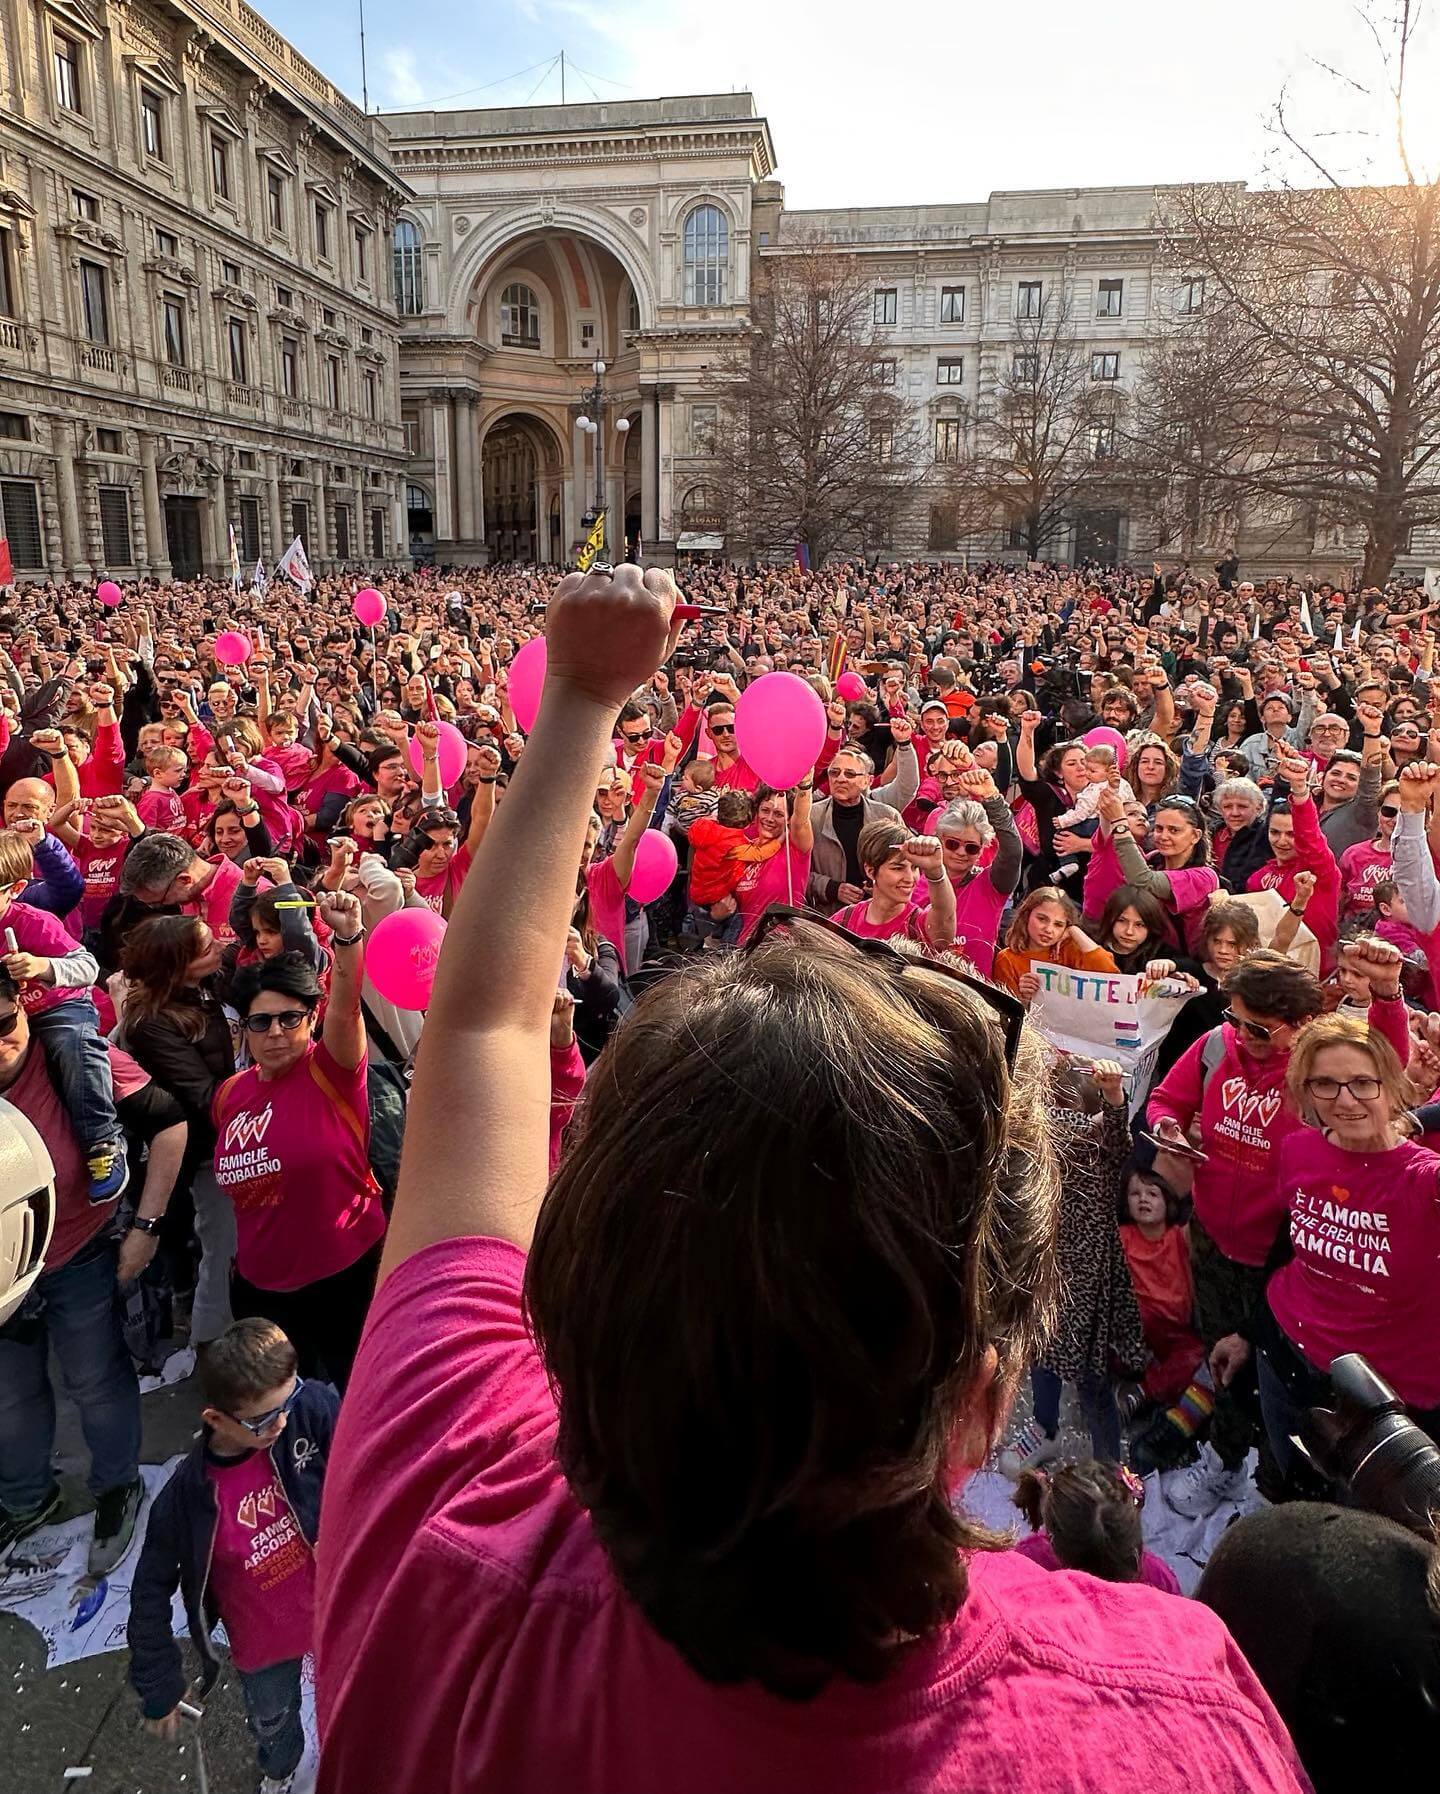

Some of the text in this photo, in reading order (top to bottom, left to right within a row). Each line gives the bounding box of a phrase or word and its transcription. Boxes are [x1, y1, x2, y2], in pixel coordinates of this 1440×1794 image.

[1036, 967, 1121, 1003] TUTTE
[219, 1146, 268, 1171] FAMIGLIE
[1290, 1209, 1392, 1253] CHE CREA UNA
[1308, 1196, 1390, 1232] L'AMORE
[1290, 1221, 1390, 1277] FAMIGLIA
